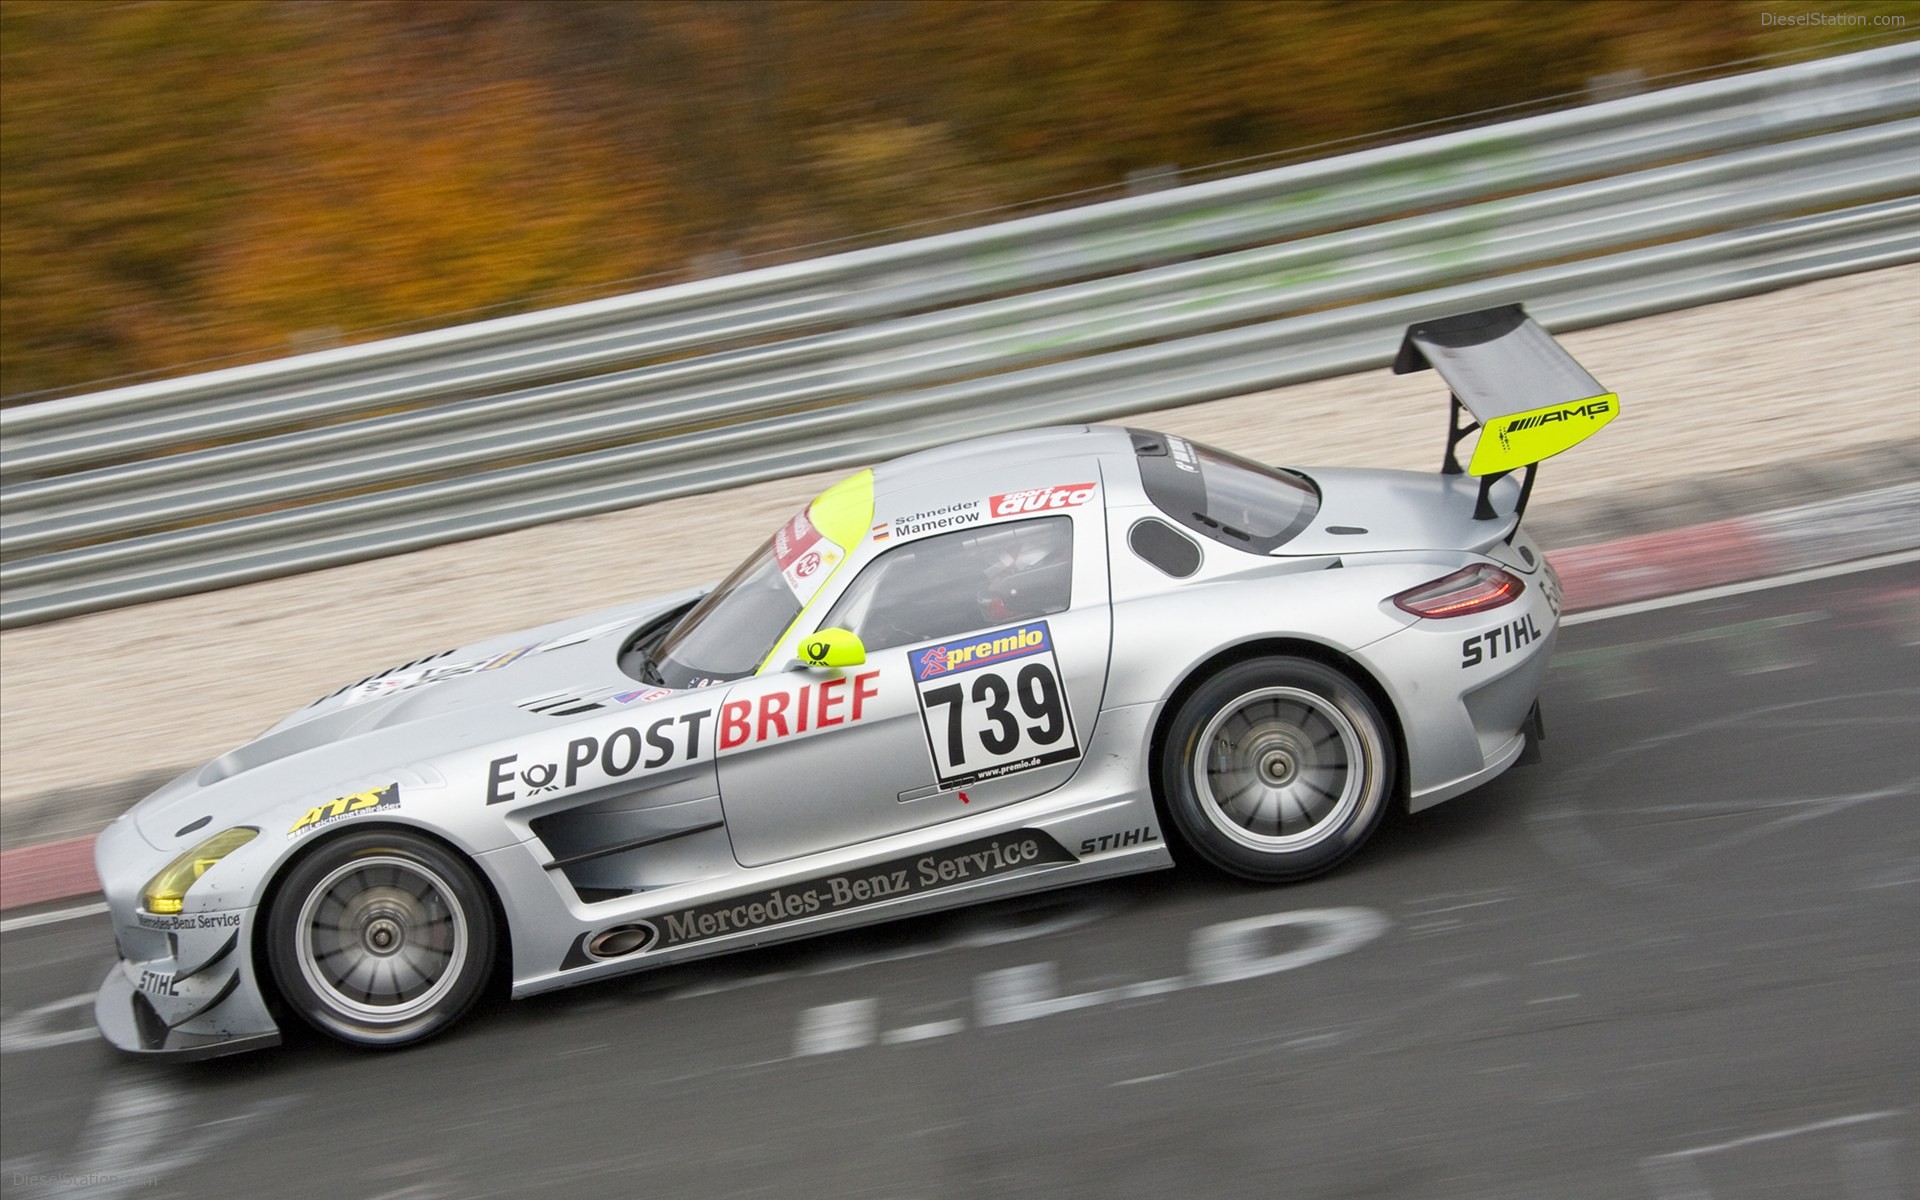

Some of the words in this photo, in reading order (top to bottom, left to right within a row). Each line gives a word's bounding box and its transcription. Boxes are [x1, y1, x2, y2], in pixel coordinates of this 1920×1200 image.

[1540, 401, 1610, 426] AMG
[997, 489, 1095, 515] auto
[1002, 487, 1055, 501] sport
[895, 500, 980, 526] Schneider
[896, 512, 980, 538] Mamerow
[947, 629, 1044, 671] premio
[1461, 613, 1542, 670] STIHL
[923, 663, 1064, 767] 739
[978, 757, 1042, 779] www.premio.de
[1080, 826, 1158, 855] STIHL
[664, 869, 910, 944] Mercedes-Benz
[919, 836, 1039, 887] Service
[197, 913, 240, 929] Service
